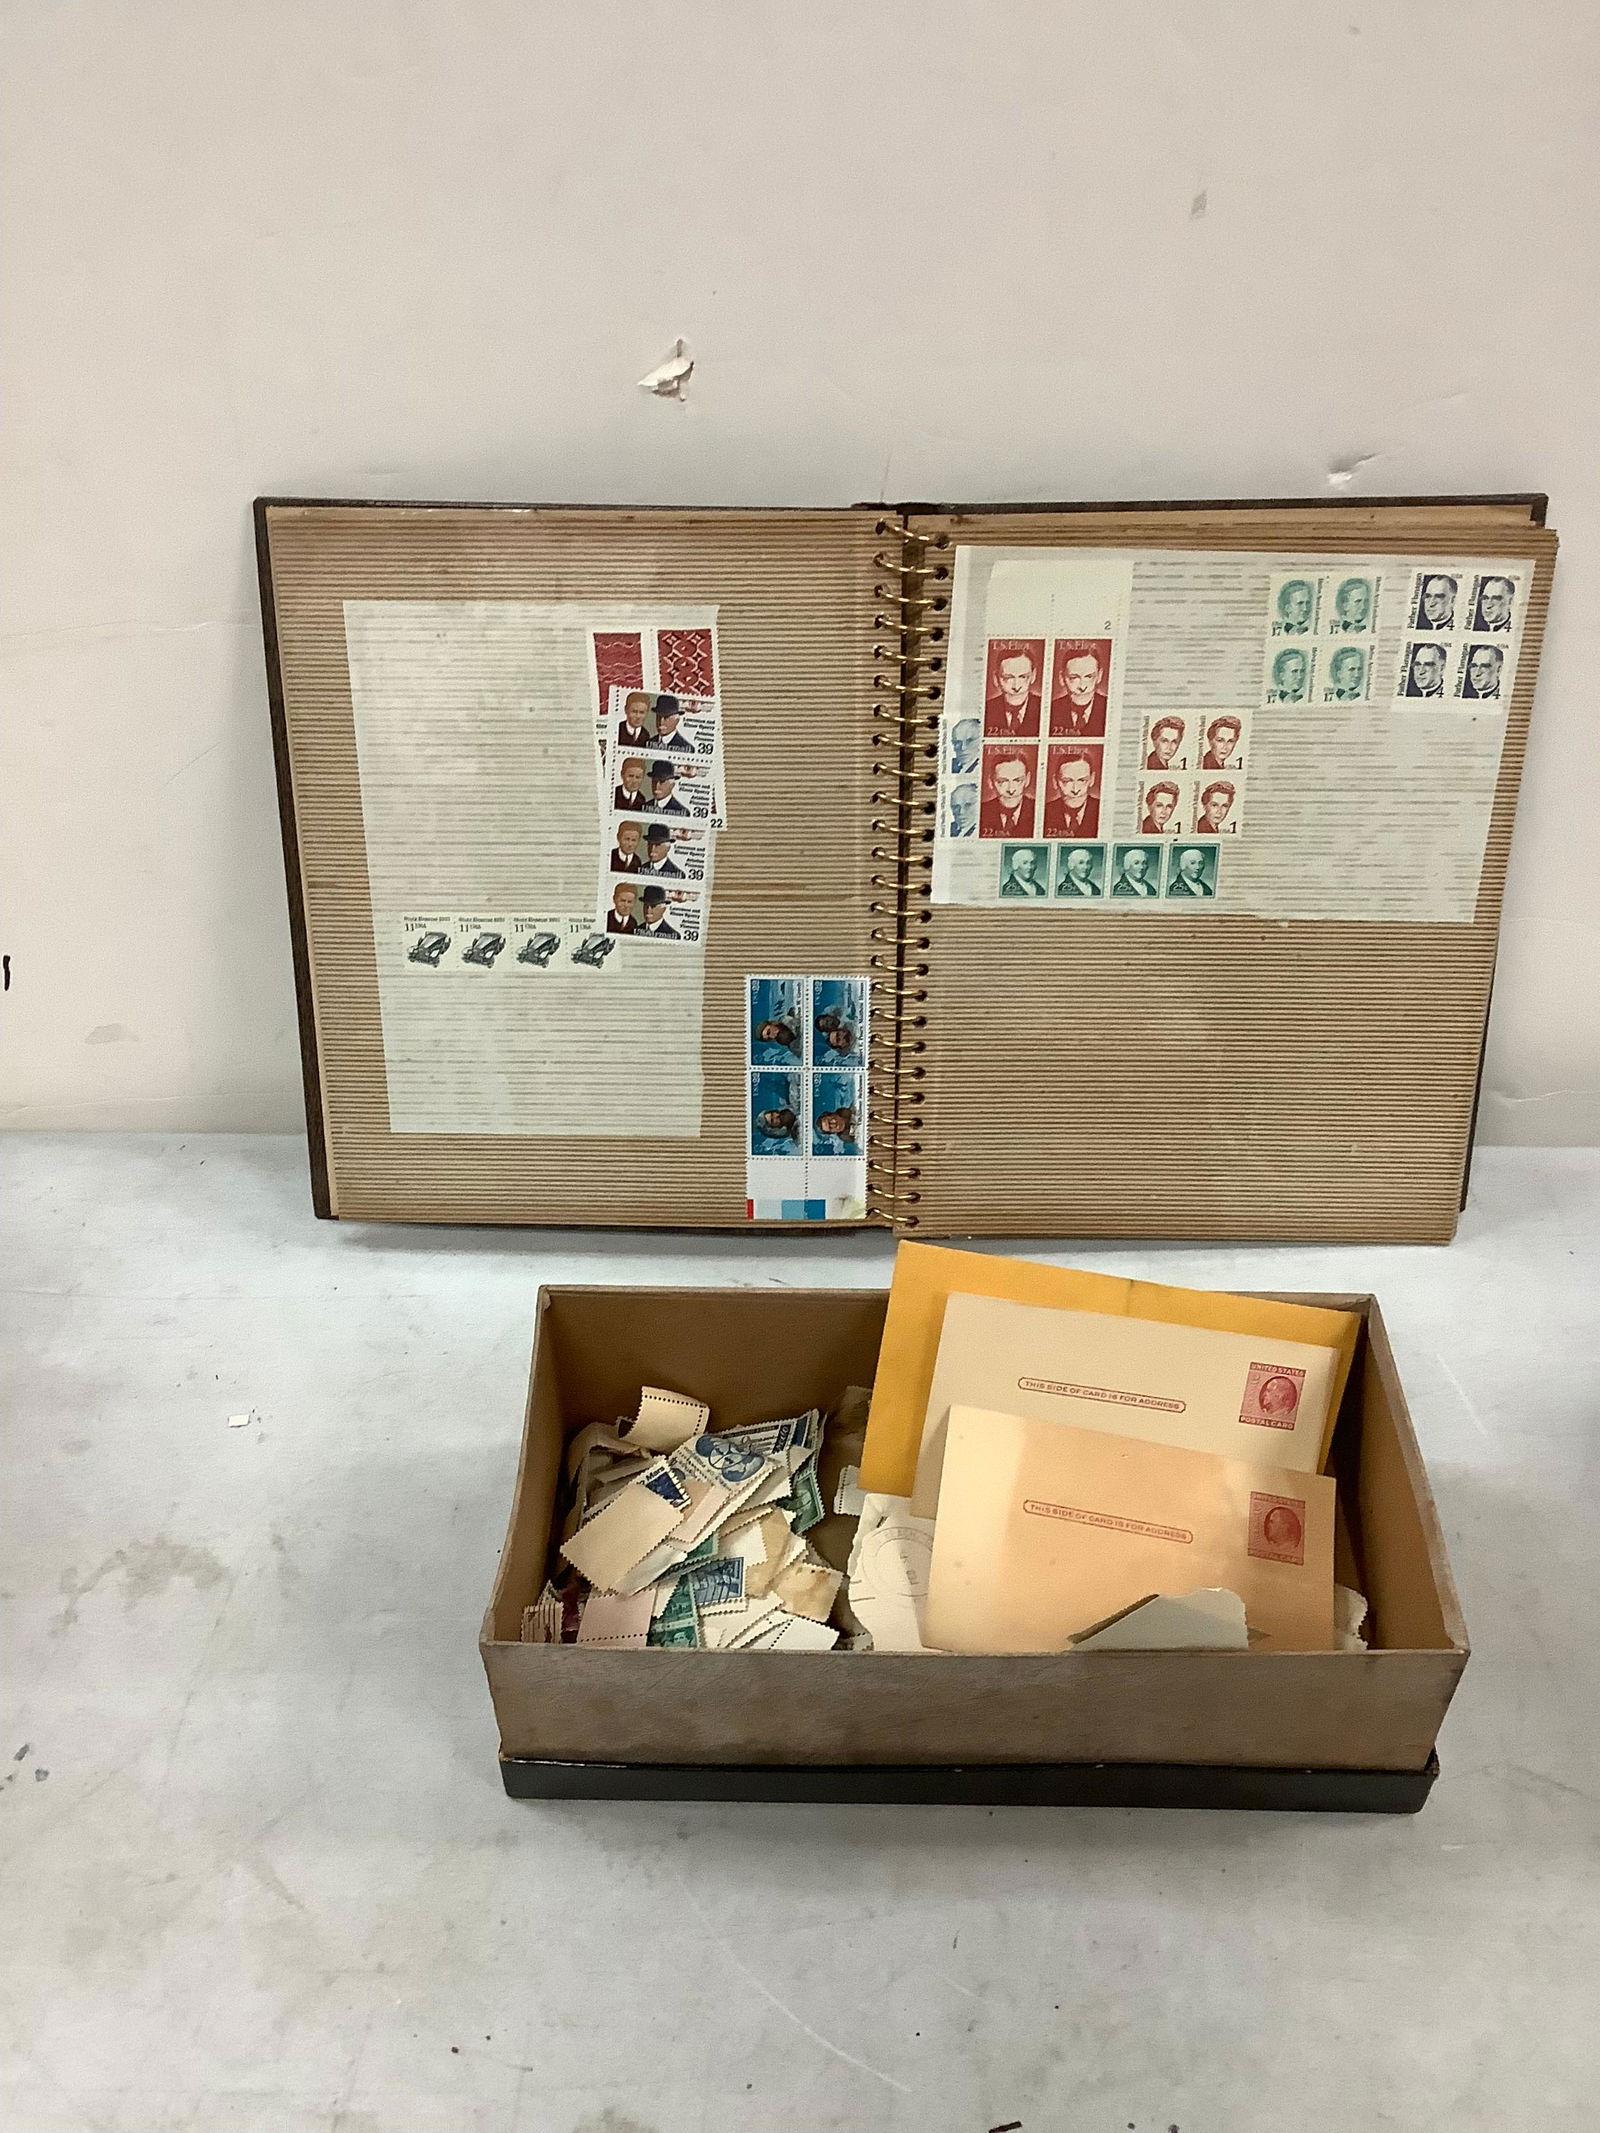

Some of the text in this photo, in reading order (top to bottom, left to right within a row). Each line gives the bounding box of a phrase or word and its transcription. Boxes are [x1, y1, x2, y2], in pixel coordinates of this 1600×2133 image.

[1104, 620, 1112, 630] 2
[1446, 619, 1455, 631] 4
[1504, 620, 1512, 632] 4
[1436, 686, 1444, 698] 4
[1493, 688, 1501, 699] 4
[987, 726, 999, 736] 22
[1052, 726, 1064, 736] 22
[698, 743, 714, 755] 39
[1180, 756, 1187, 770] 1
[1236, 756, 1243, 770] 1
[692, 807, 709, 819] 39
[710, 819, 723, 828] 22
[1174, 821, 1182, 834] 1
[1229, 821, 1237, 834] 1
[982, 828, 994, 837] 22
[1046, 828, 1058, 837] 22
[688, 869, 704, 880] 39
[405, 923, 414, 932] 11
[460, 924, 469, 932] 11
[515, 924, 524, 932] 11
[570, 924, 578, 933] 11
[684, 930, 699, 941] 39
[1251, 1363, 1304, 1377] UNITED STATES
[1024, 1381, 1045, 1389] THIS
[1047, 1384, 1068, 1393] SIDE
[1082, 1389, 1107, 1398] CARD
[1120, 1395, 1138, 1403] FOR
[1138, 1398, 1180, 1410] ADDRESS
[1270, 1420, 1294, 1430] CARD
[645, 1466, 665, 1482] Mars
[1030, 1504, 1051, 1513] THIS
[1052, 1508, 1074, 1518] SIDE
[1089, 1515, 1114, 1526] CARD
[1115, 1520, 1124, 1528] IS
[1125, 1522, 1144, 1531] FOR
[1145, 1526, 1187, 1540] ADDRESS
